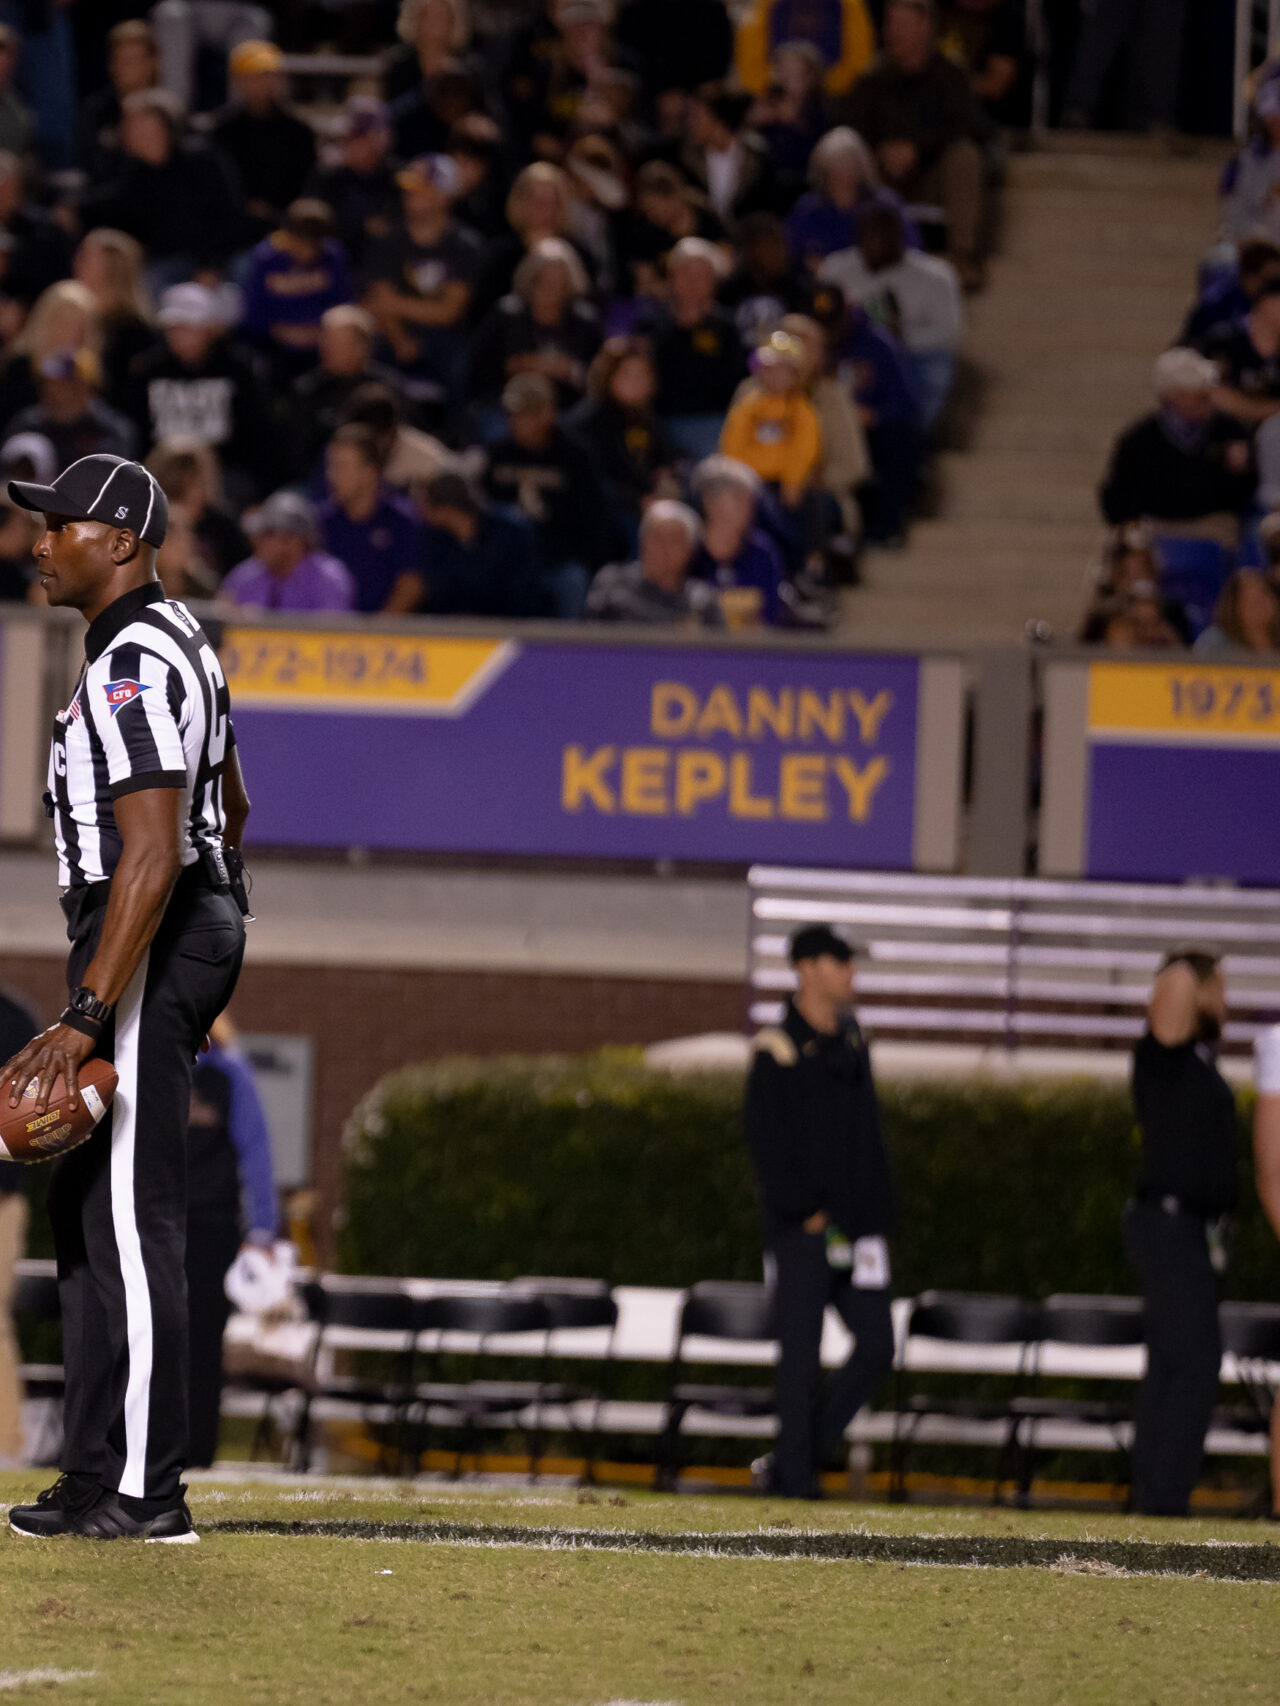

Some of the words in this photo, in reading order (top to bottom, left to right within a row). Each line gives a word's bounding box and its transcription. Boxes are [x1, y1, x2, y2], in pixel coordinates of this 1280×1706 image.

[115, 506, 129, 519] S
[223, 641, 428, 686] 972-1974
[650, 680, 893, 746] DANNY
[562, 743, 891, 824] KEPLEY
[26, 1110, 60, 1132] DIME
